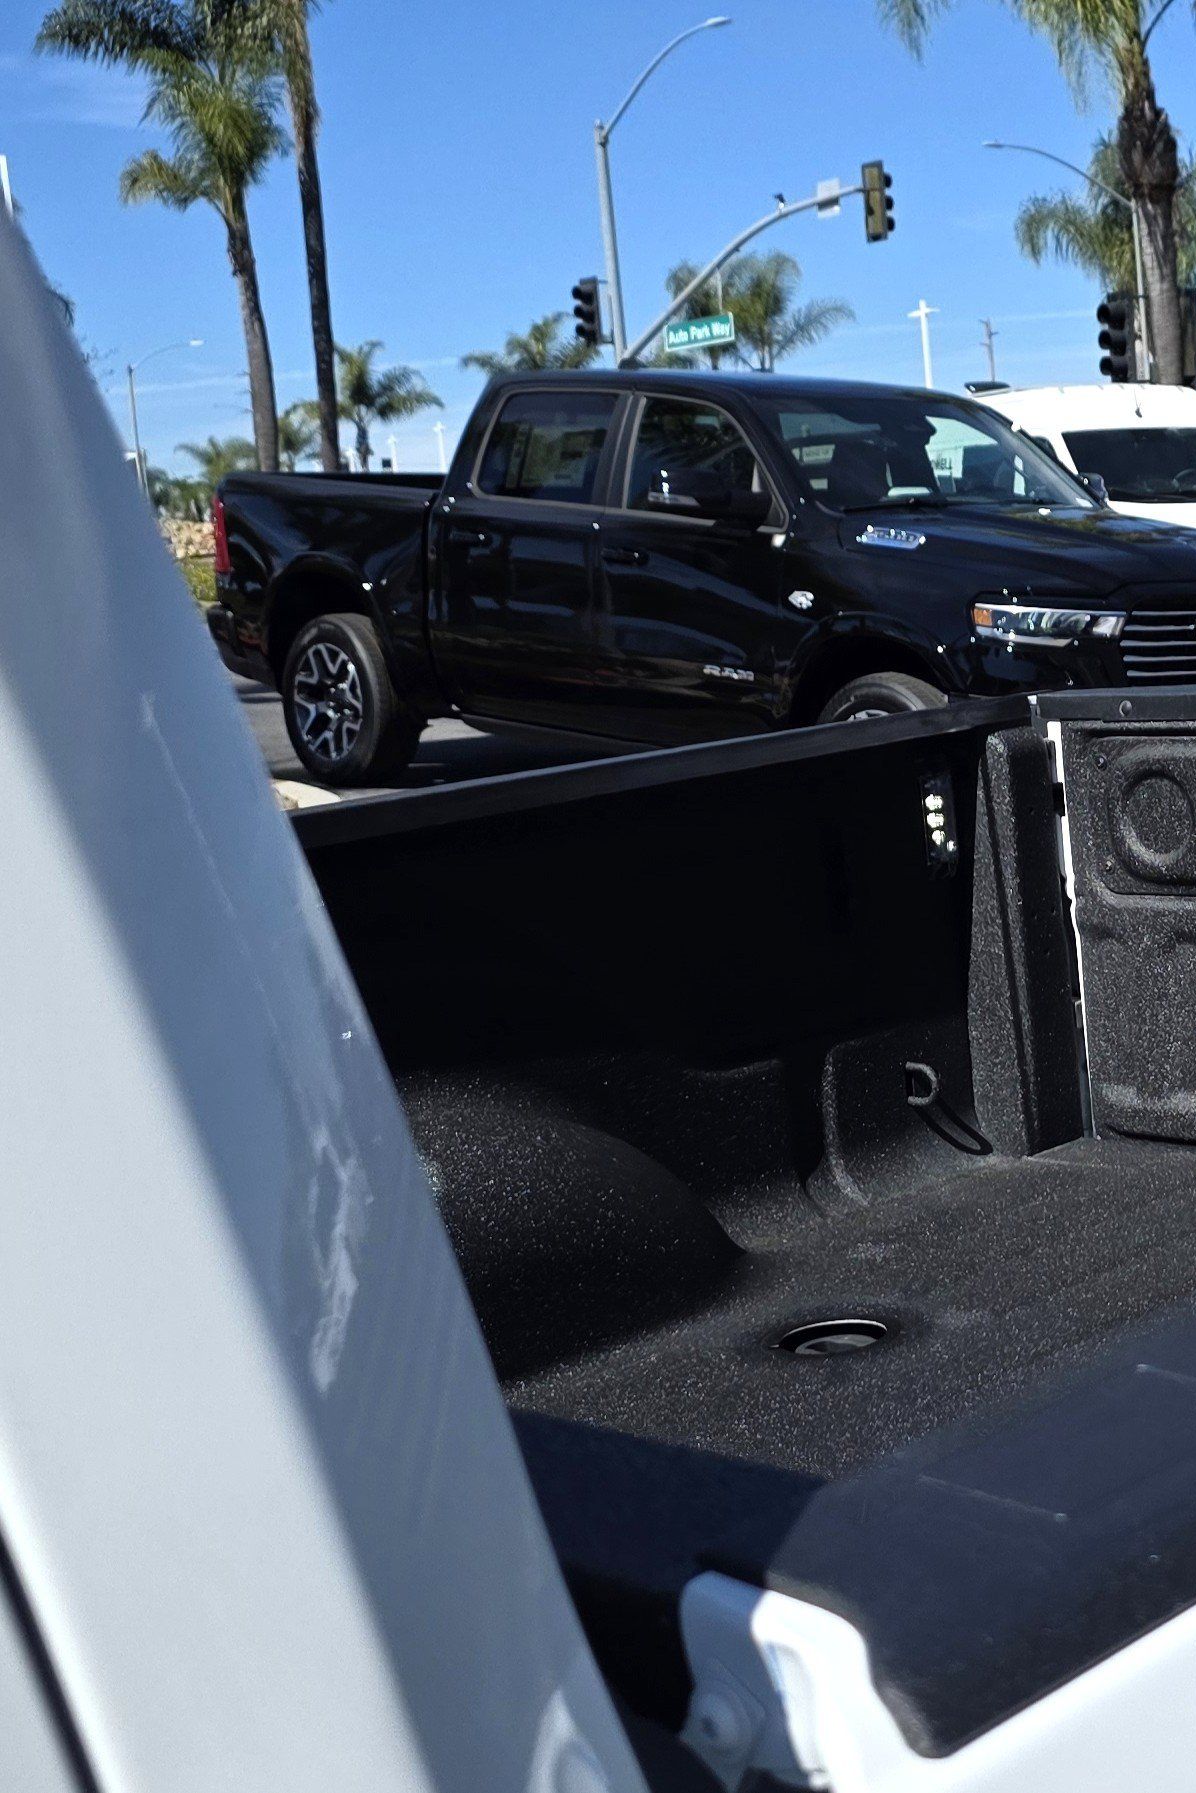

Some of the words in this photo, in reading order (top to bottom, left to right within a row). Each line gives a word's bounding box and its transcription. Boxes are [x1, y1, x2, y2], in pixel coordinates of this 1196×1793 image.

[669, 329, 689, 344] Auto
[690, 323, 711, 340] Park
[711, 321, 730, 336] Way
[702, 664, 755, 682] RAM
